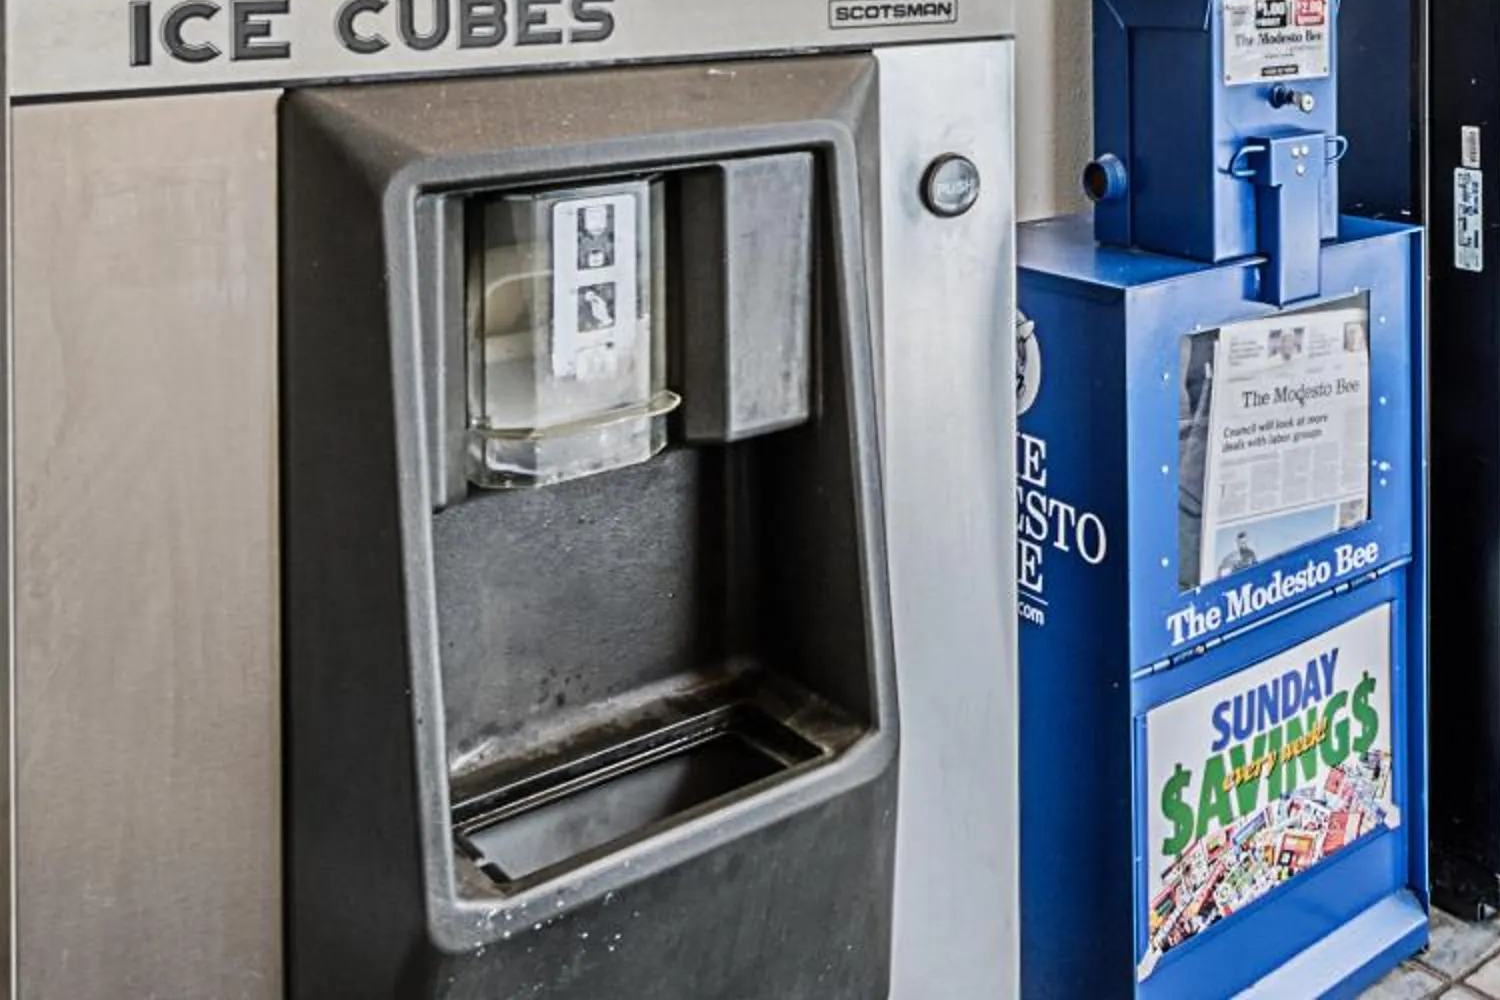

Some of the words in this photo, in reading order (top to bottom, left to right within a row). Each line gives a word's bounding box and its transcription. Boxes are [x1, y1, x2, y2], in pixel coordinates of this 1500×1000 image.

[835, 2, 953, 22] SCOTSMAN
[1235, 33, 1254, 47] The
[1259, 31, 1303, 45] Modesto
[1306, 28, 1323, 41] Bee
[1243, 390, 1271, 408] The
[1273, 382, 1333, 405] Modesto
[1336, 377, 1360, 395] Bee
[1166, 602, 1222, 647] The
[1223, 562, 1331, 624] Modesto
[1334, 541, 1379, 578] Bee
[1211, 648, 1339, 753] SUNDAY
[1161, 669, 1380, 858] $AVING$
[1223, 749, 1278, 793] every
